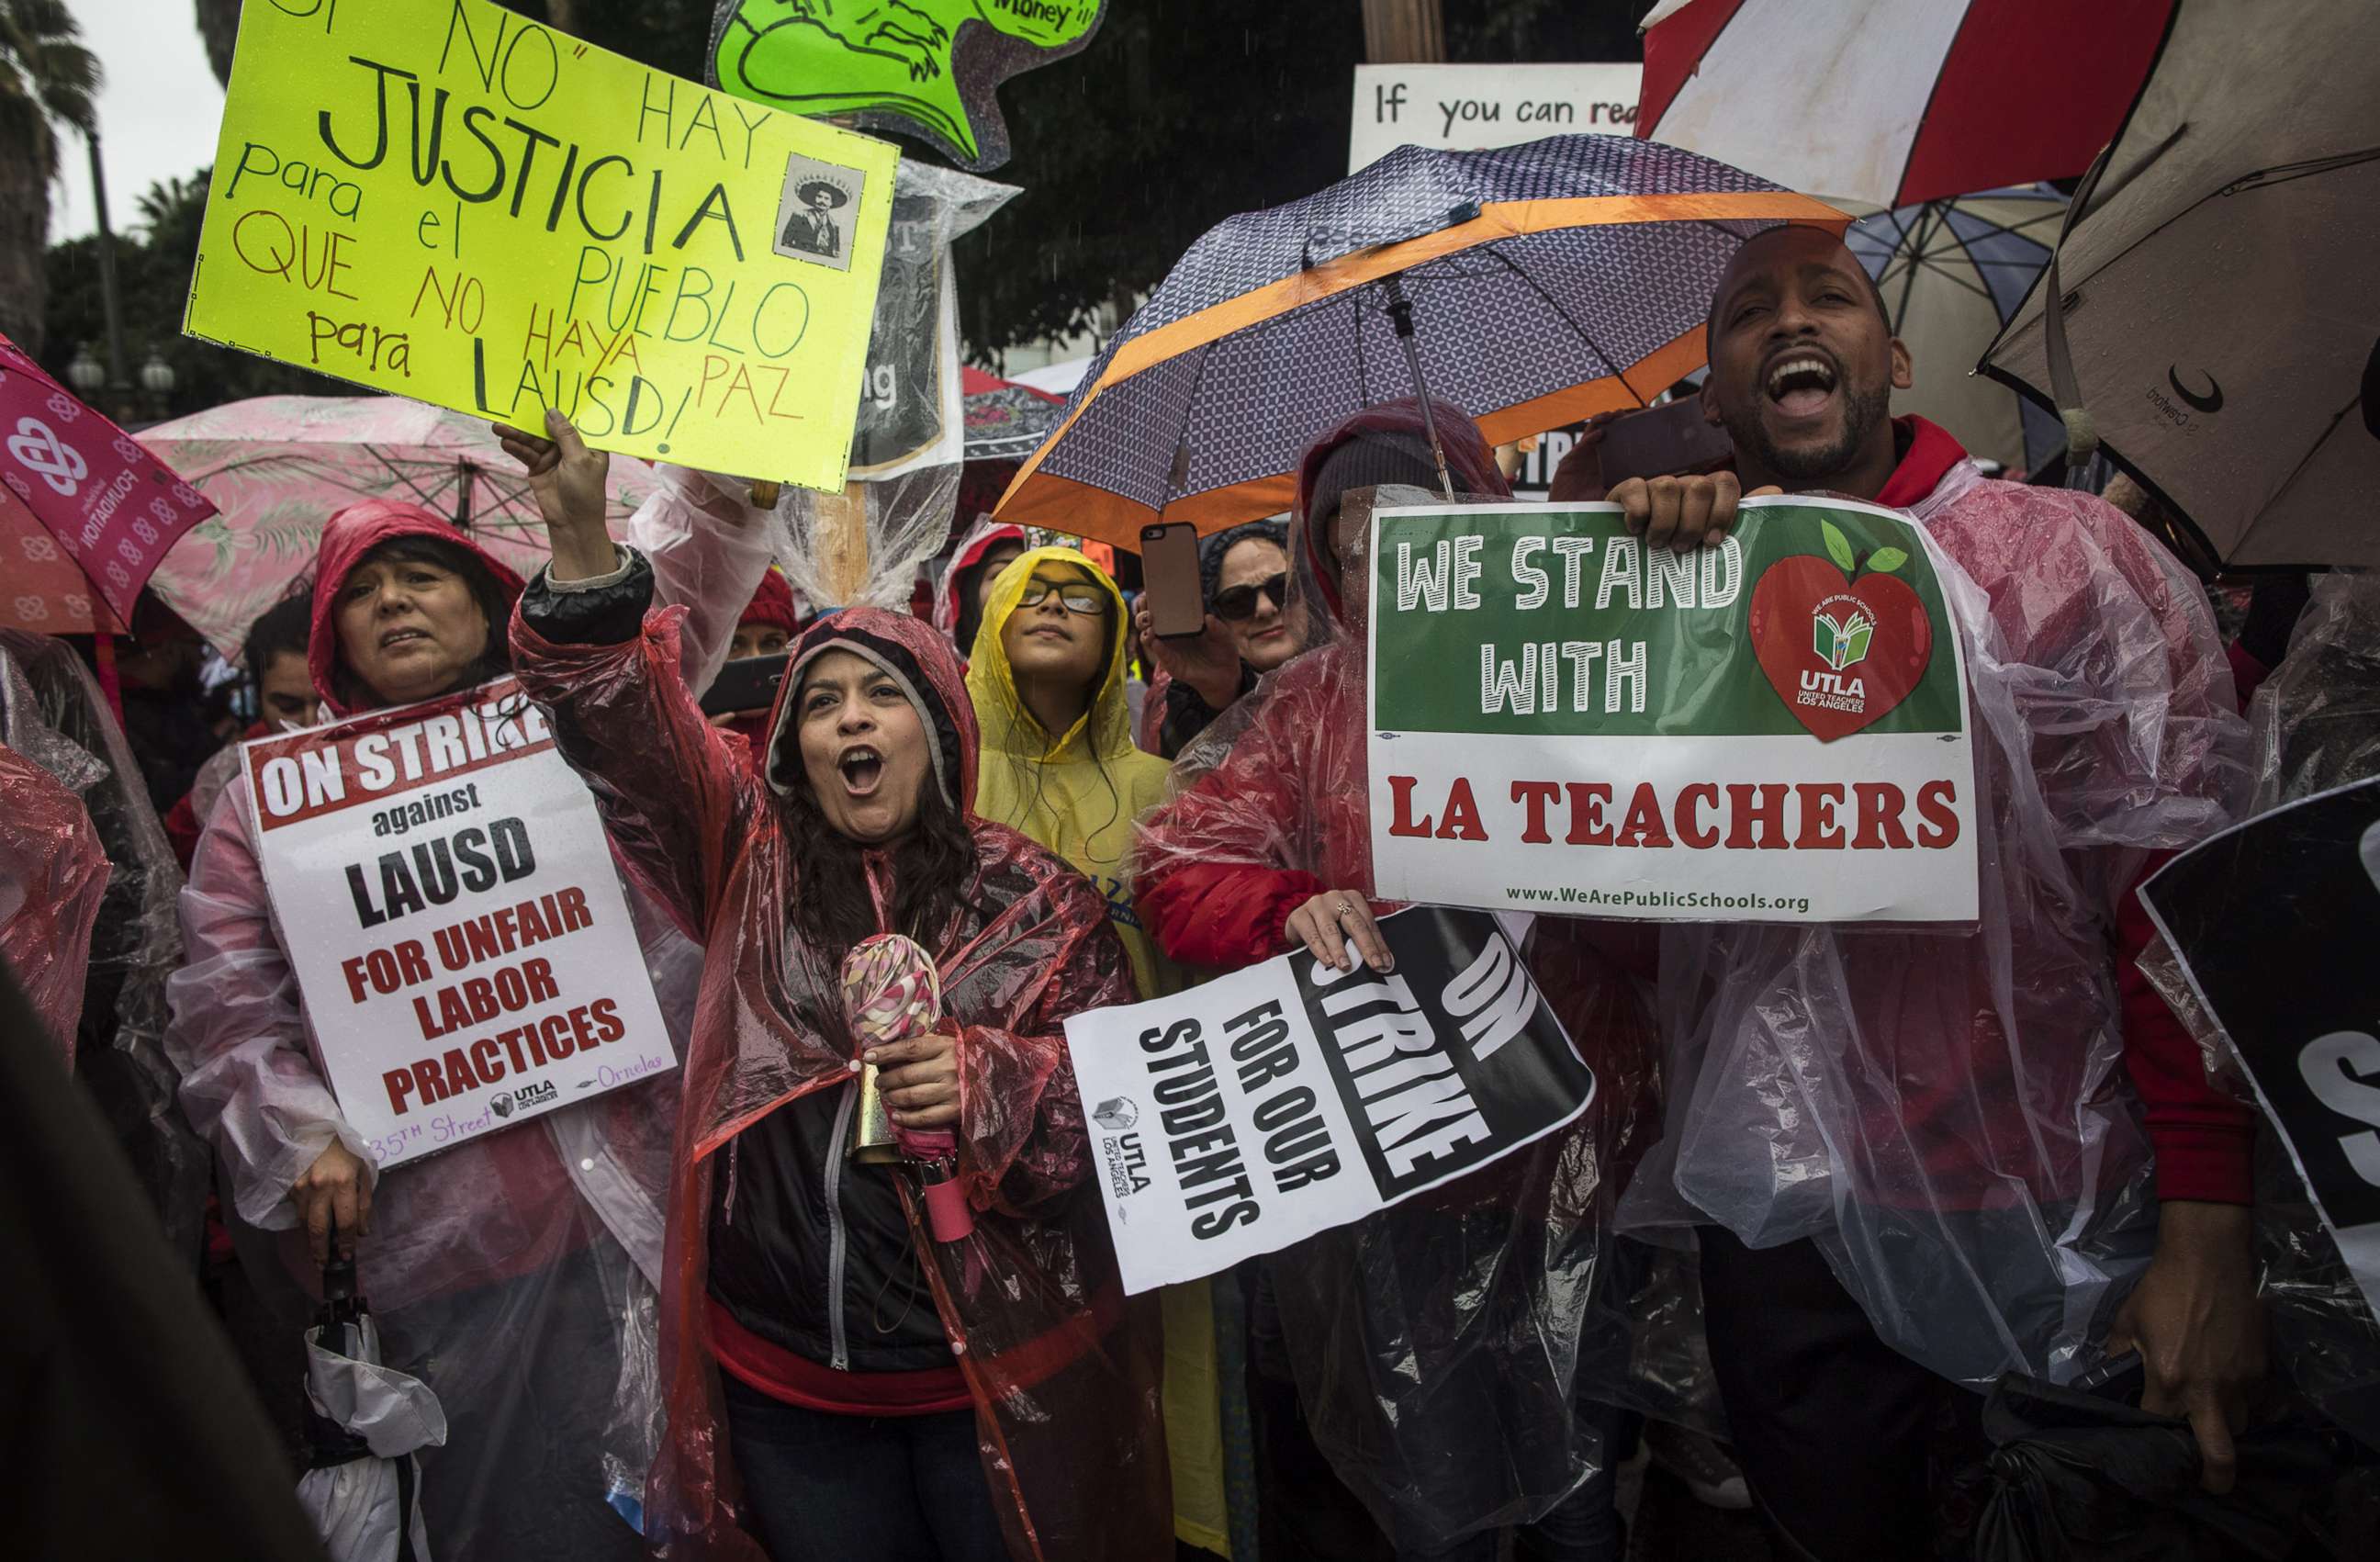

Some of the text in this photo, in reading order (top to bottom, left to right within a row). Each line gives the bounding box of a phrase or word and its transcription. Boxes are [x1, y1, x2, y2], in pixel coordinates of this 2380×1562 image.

[637, 71, 772, 170] HAY
[1375, 83, 1640, 139] If you can rea
[318, 54, 746, 263] JUSTICIA
[225, 141, 811, 359] para el PUEBLO
[232, 209, 359, 301] QUE
[410, 265, 485, 335] NO
[522, 301, 643, 390] HAYA
[697, 354, 804, 426] PAZ
[307, 309, 411, 377] para
[1397, 534, 1744, 612] WE STAND
[1822, 595, 1835, 608] ARE
[1834, 593, 1858, 604] PUBLIC
[1855, 599, 1879, 627] SCHOOLS
[1479, 637, 1648, 715] WITH
[1796, 695, 1865, 714] LOS ANGELES
[1798, 689, 1866, 707] UNITED TEACHERS
[1800, 669, 1866, 699] UTLA
[261, 744, 347, 818] ON
[371, 781, 482, 838] against
[1386, 775, 1961, 851] LA TEACHERS
[344, 815, 537, 930] LAUSD
[1505, 887, 1810, 914] www.WeArePublicSchools.org
[341, 885, 595, 1005] FOR UNFAIR
[411, 957, 561, 1041] LABOR
[1440, 930, 1538, 1062] ON
[381, 997, 626, 1117] PRACTICES
[513, 1079, 556, 1102] UTLA
[430, 1105, 491, 1142] Street
[1139, 1017, 1262, 1242] STUDENTS
[1222, 997, 1342, 1195] FOR OUR
[1102, 1136, 1126, 1200] LOS ANGELES
[1119, 1131, 1152, 1195] UTLA
